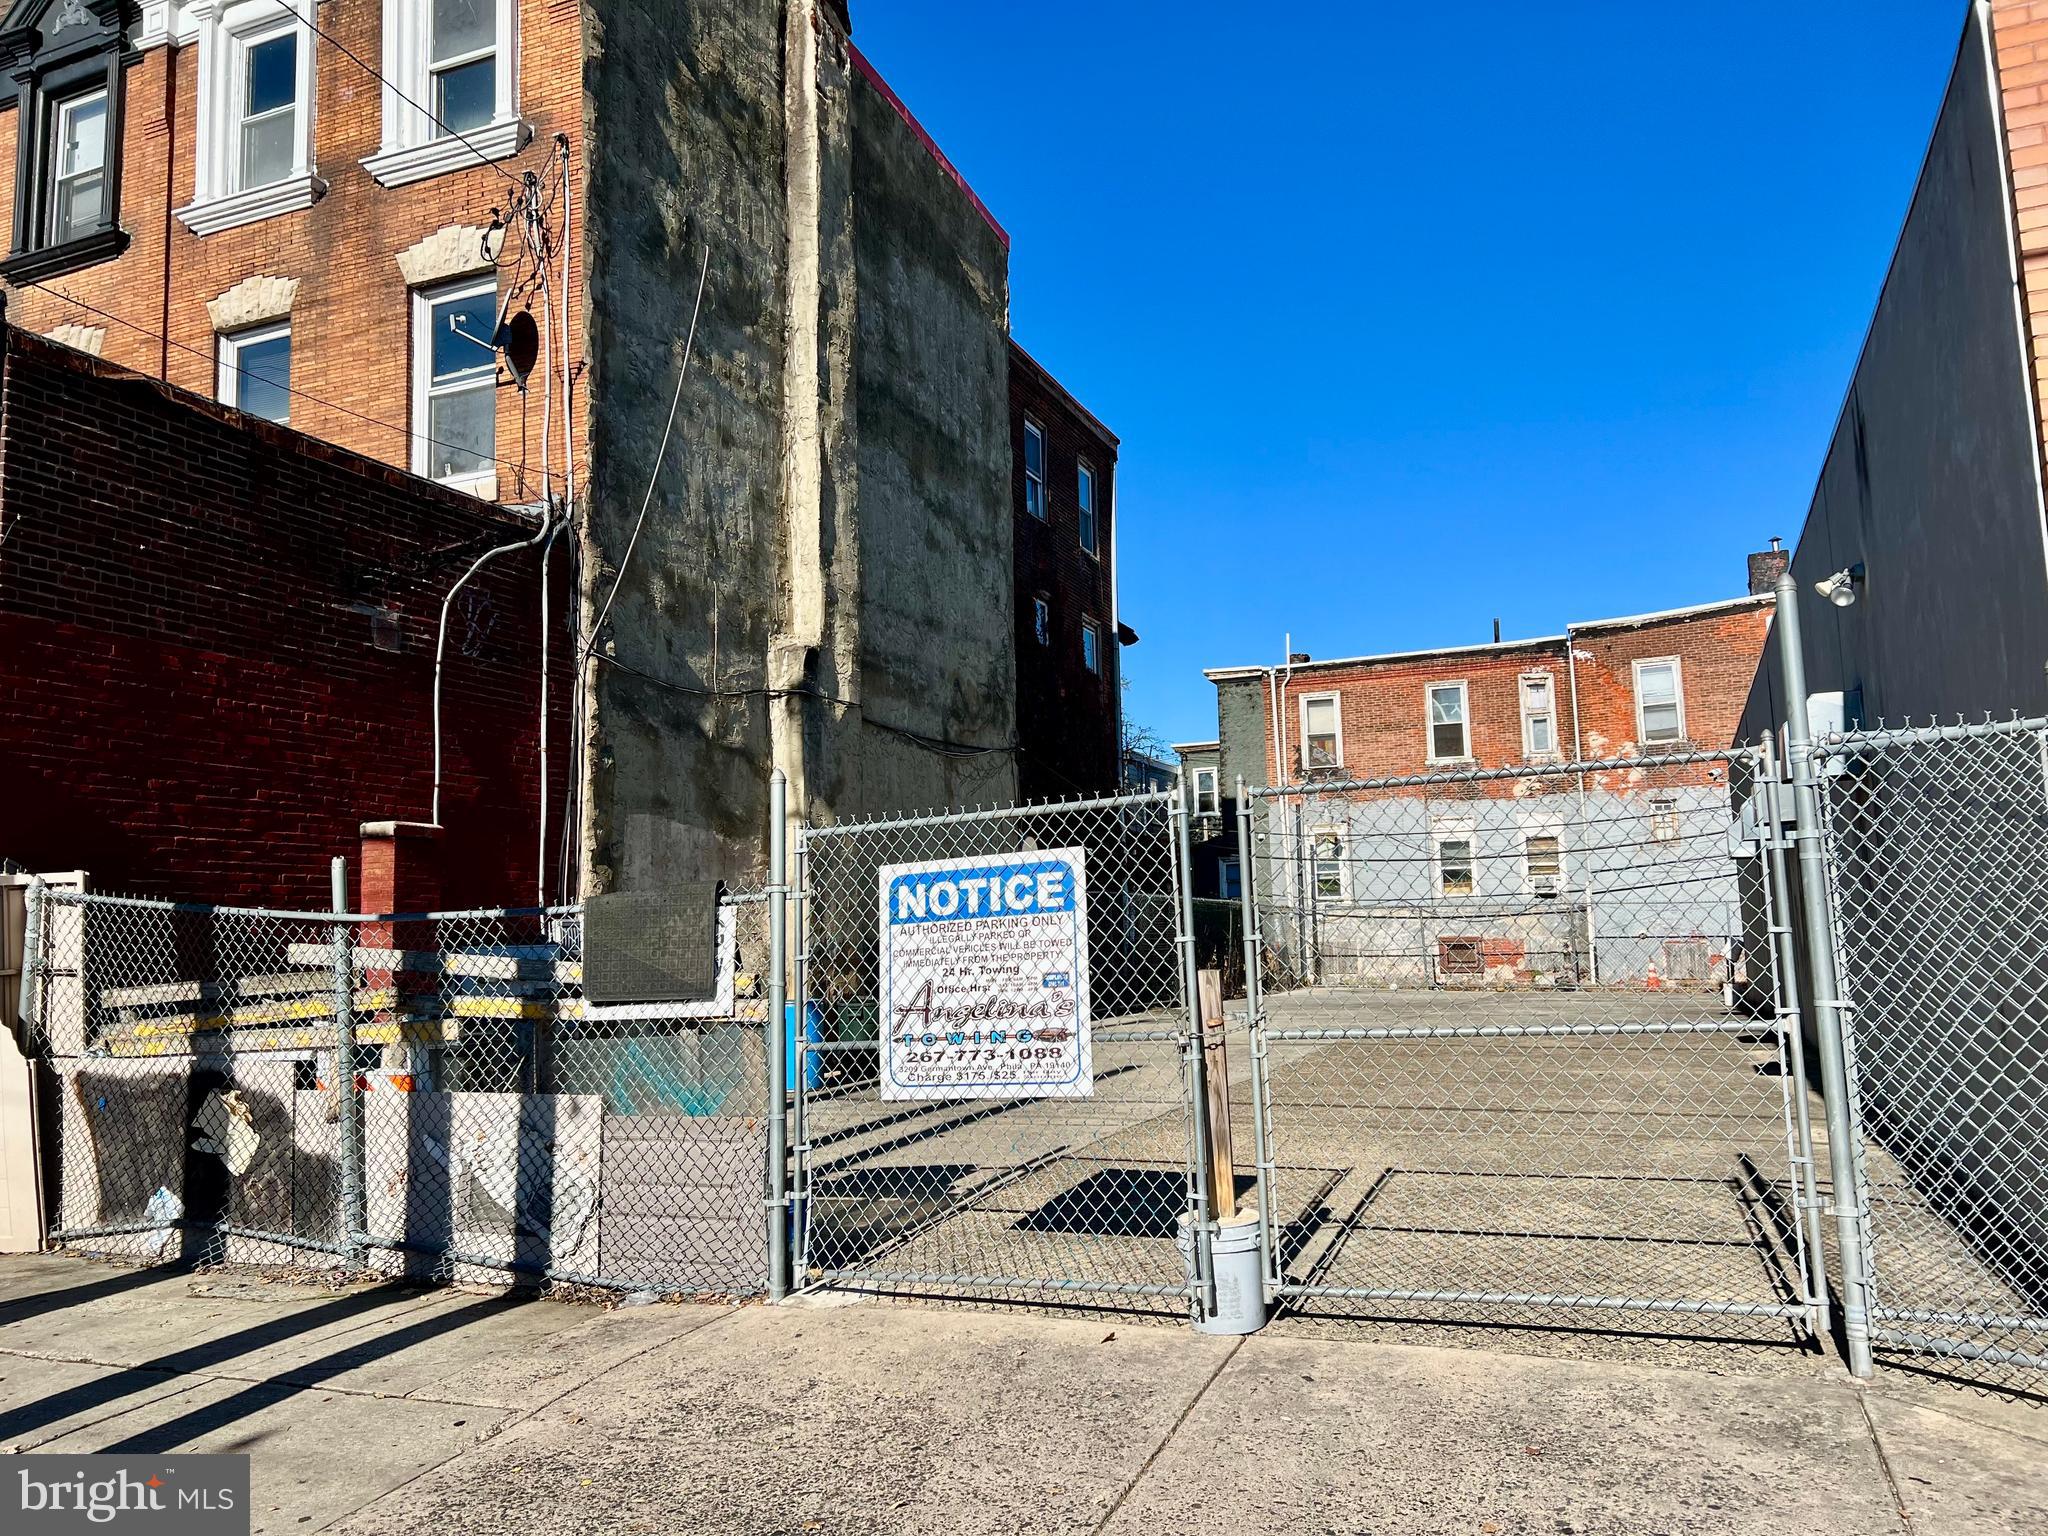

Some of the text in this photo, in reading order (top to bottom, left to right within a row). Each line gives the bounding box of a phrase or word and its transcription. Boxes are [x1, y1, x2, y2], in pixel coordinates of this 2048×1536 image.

[898, 871, 1064, 919] NOTICE
[900, 915, 1064, 937] AUTHORIZED PARKING ONLY
[929, 929, 1032, 944] ILLEGALLY PARKED OR
[893, 938, 1073, 958] COMMERCIAL VEHICLES WILL BE TOWED
[903, 950, 1061, 968] IMMEDIATELY FROM THE PROPERTY
[942, 968, 955, 977] 24
[978, 965, 1020, 976] Towing
[937, 984, 968, 994] Office
[893, 978, 1075, 1036] Angelina's
[902, 1029, 1034, 1047] TOWING
[906, 1047, 1063, 1063] 267-773-1088
[920, 1063, 975, 1073] Germantown
[907, 1071, 952, 1084] Charge
